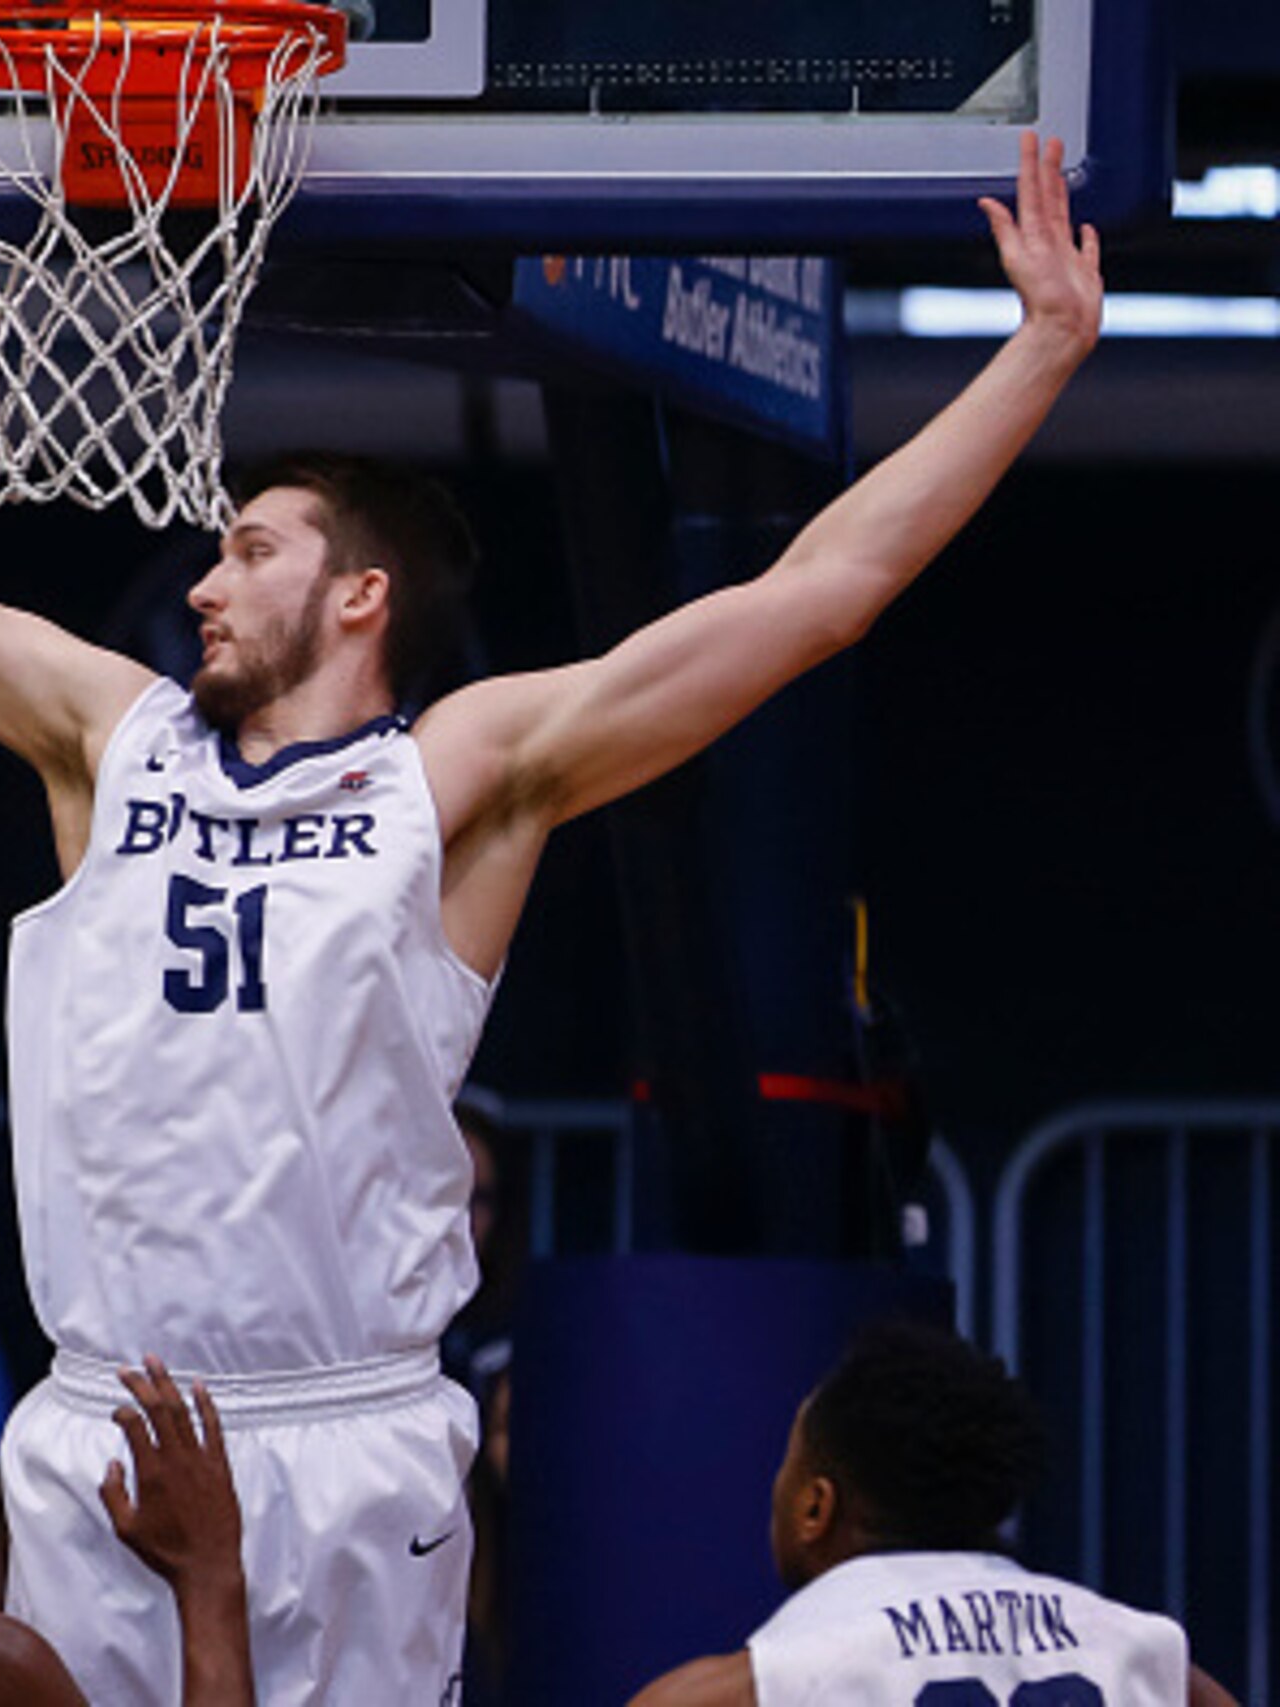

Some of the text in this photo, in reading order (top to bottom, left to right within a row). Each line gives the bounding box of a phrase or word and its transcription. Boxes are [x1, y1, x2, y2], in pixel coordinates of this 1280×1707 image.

[729, 293, 821, 401] Athletics
[163, 872, 269, 1014] 51
[882, 1589, 1080, 1658] MARTIN
